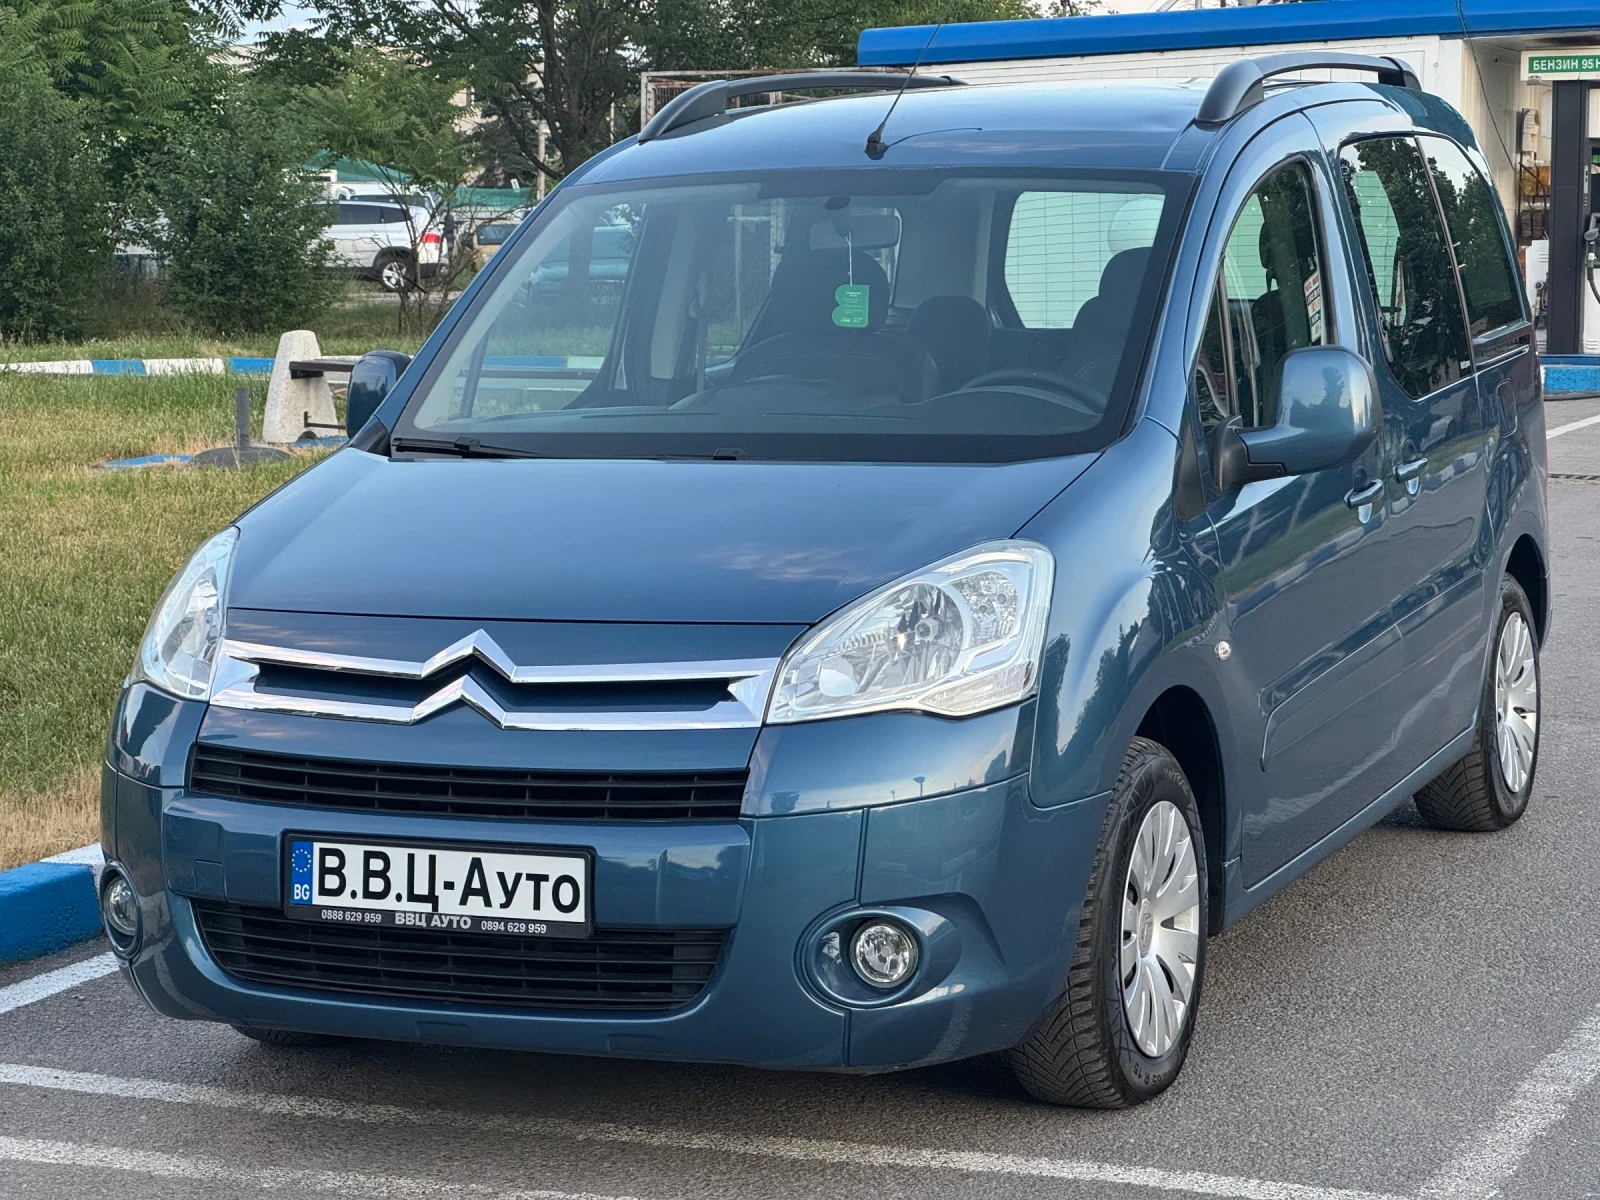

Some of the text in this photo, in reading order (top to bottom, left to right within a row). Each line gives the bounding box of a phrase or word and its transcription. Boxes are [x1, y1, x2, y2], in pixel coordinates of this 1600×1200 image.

[1533, 59, 1578, 71] БЕНЗИН
[318, 847, 581, 914] В.В.Ц-Ауто
[293, 883, 310, 901] BG
[321, 909, 382, 924] 0888 629 959
[395, 912, 472, 930] ВВЦ АУТО
[481, 920, 547, 935] 0894 629 959
